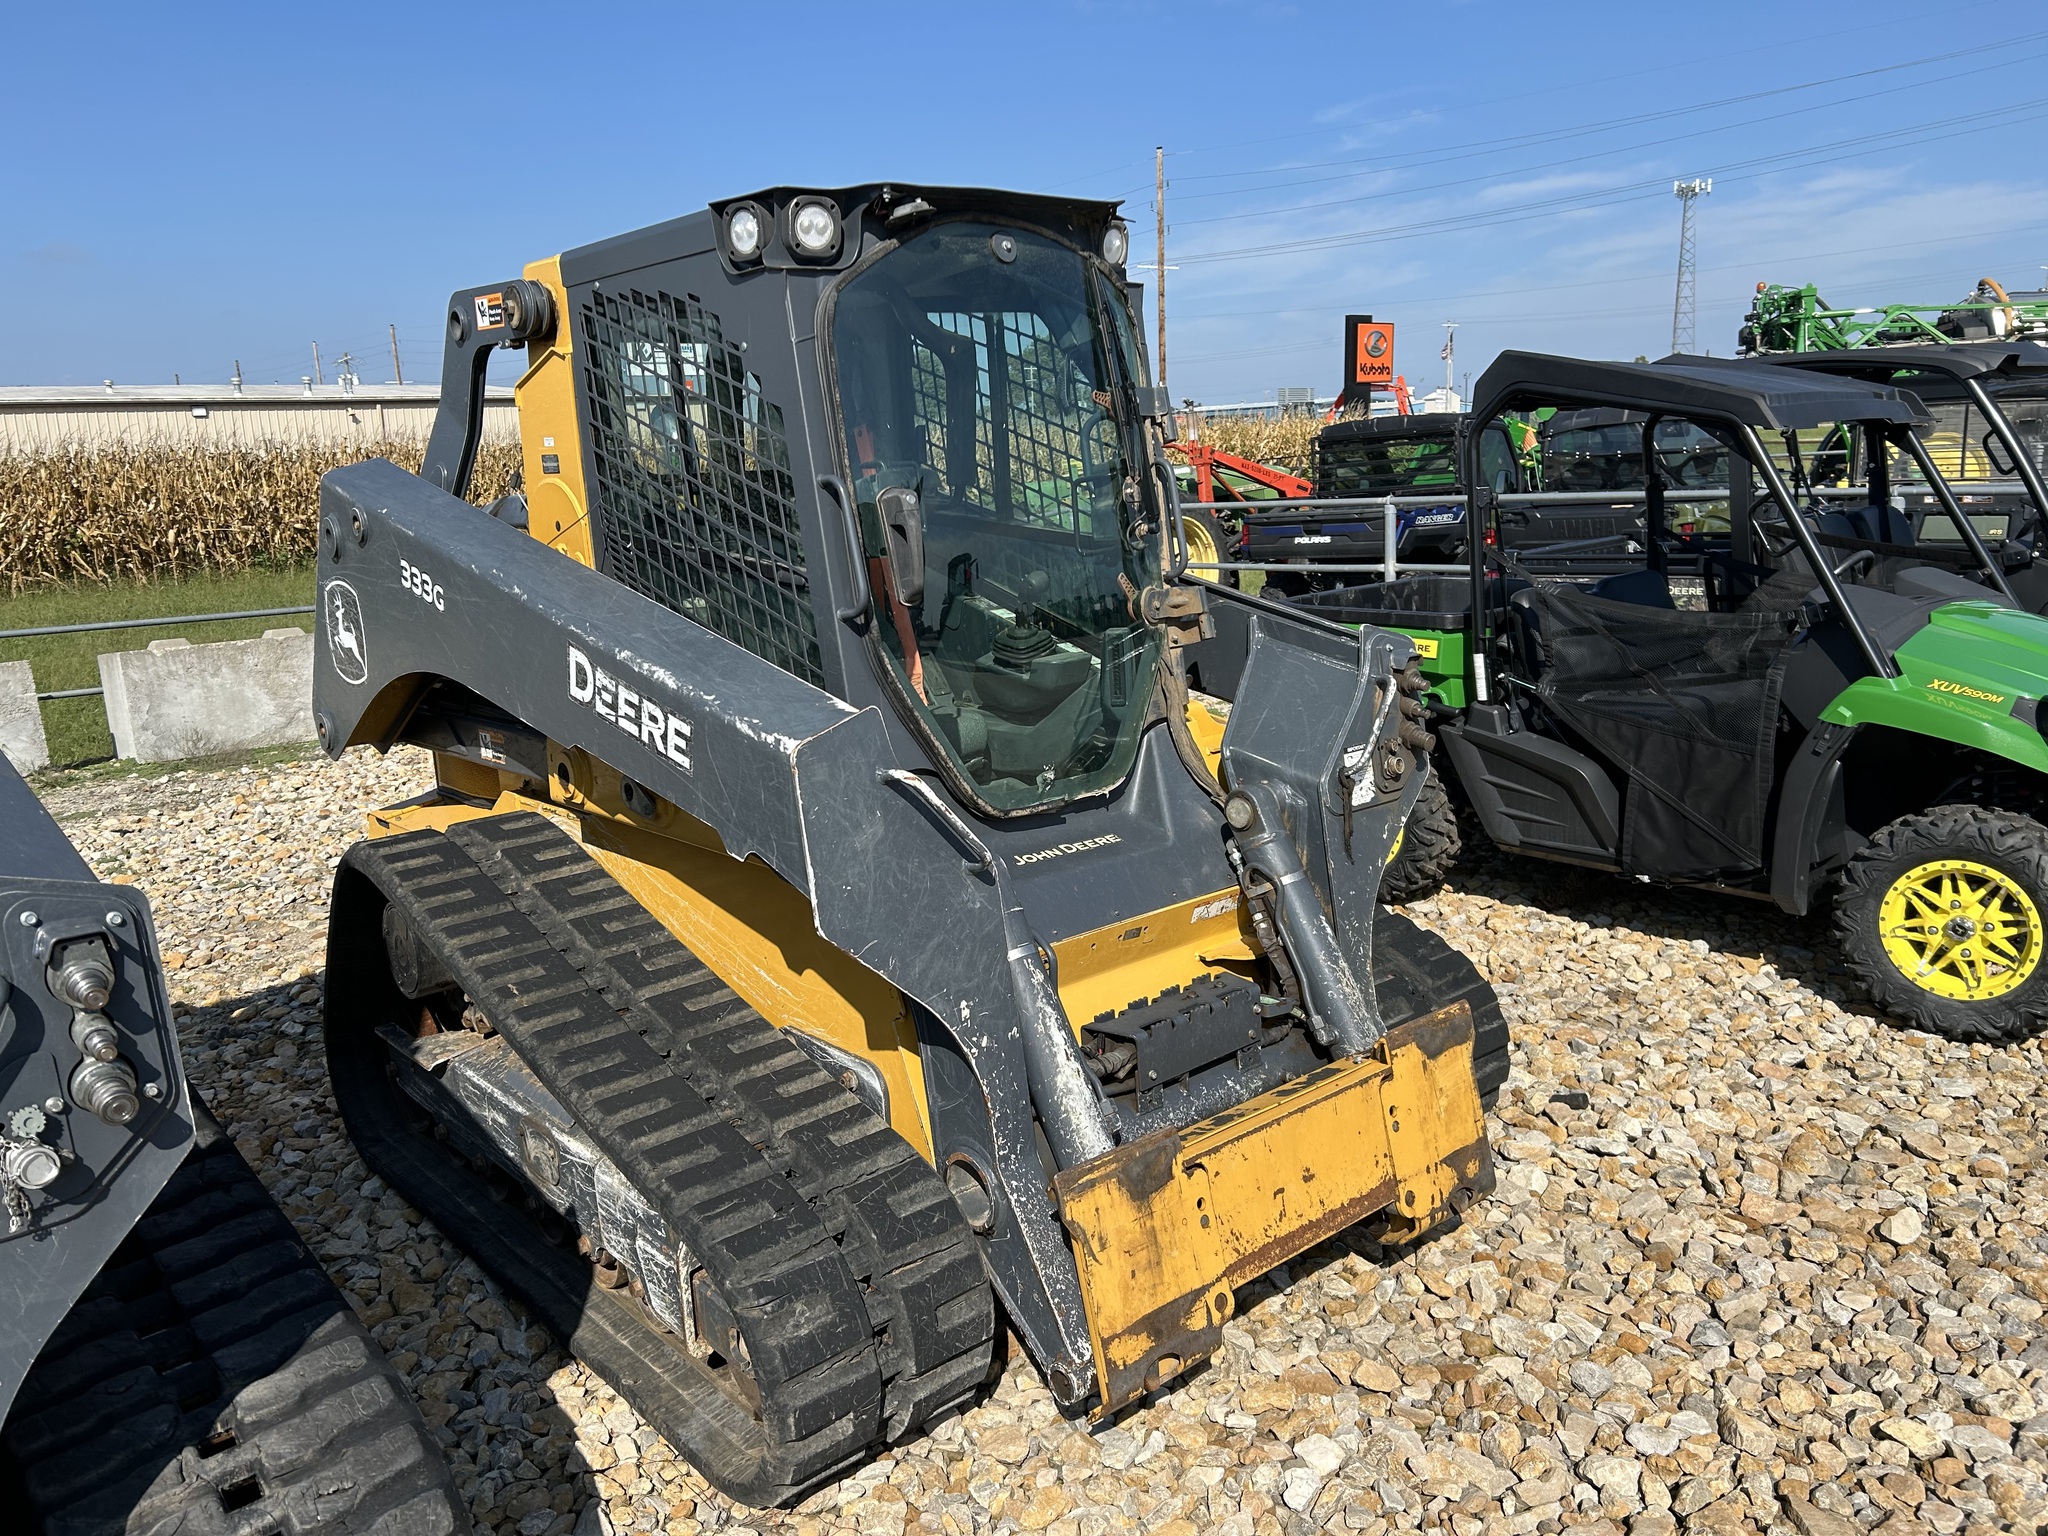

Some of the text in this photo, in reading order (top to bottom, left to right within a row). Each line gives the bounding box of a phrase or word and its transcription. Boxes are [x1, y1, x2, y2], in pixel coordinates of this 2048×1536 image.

[1359, 362, 1391, 376] Kubota
[1415, 513, 1455, 525] RANGER
[1294, 535, 1332, 545] POLARIS
[399, 558, 446, 613] 333G
[1668, 585, 1704, 596] DEERE
[1926, 678, 2005, 704] XUV590M
[567, 642, 693, 774] DEERE
[1013, 833, 1122, 867] JOHN DEERE
